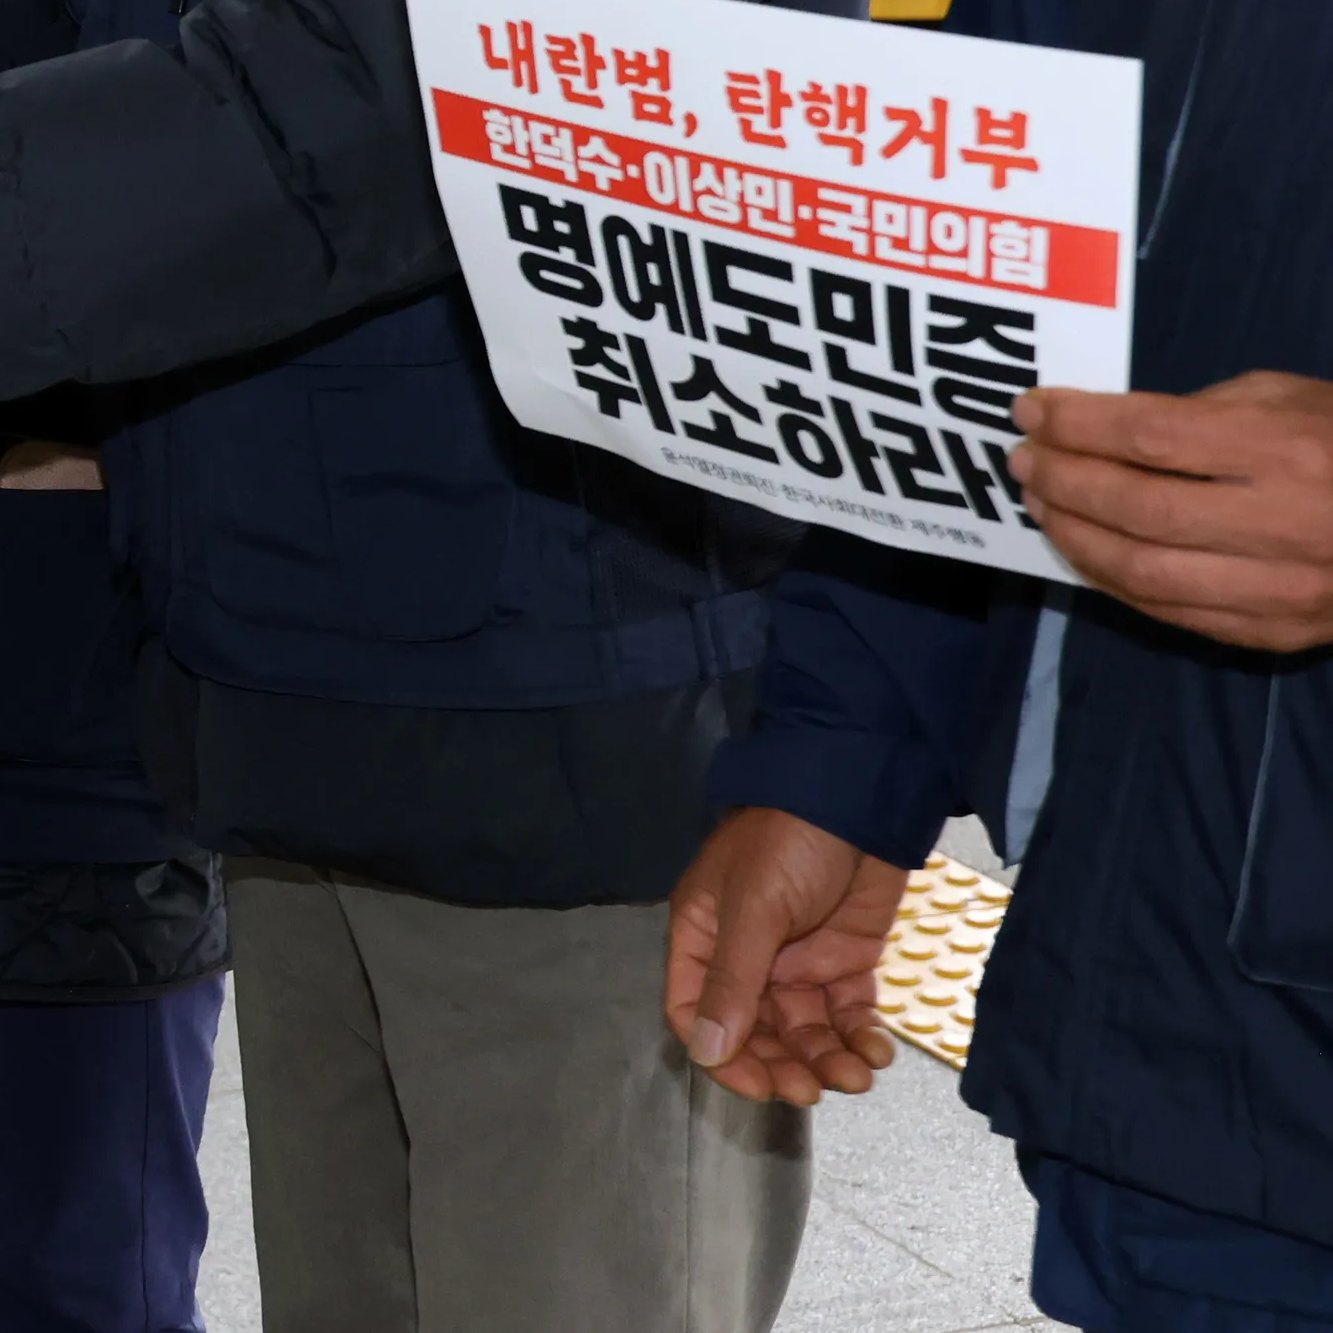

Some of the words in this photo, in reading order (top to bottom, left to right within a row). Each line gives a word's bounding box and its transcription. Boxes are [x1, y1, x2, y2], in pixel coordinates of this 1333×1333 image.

[478, 20, 699, 139] 내란범,
[726, 68, 1040, 191] 탄핵거부
[498, 183, 1039, 435] 명예도민증
[561, 314, 1041, 530] 취소하라!
